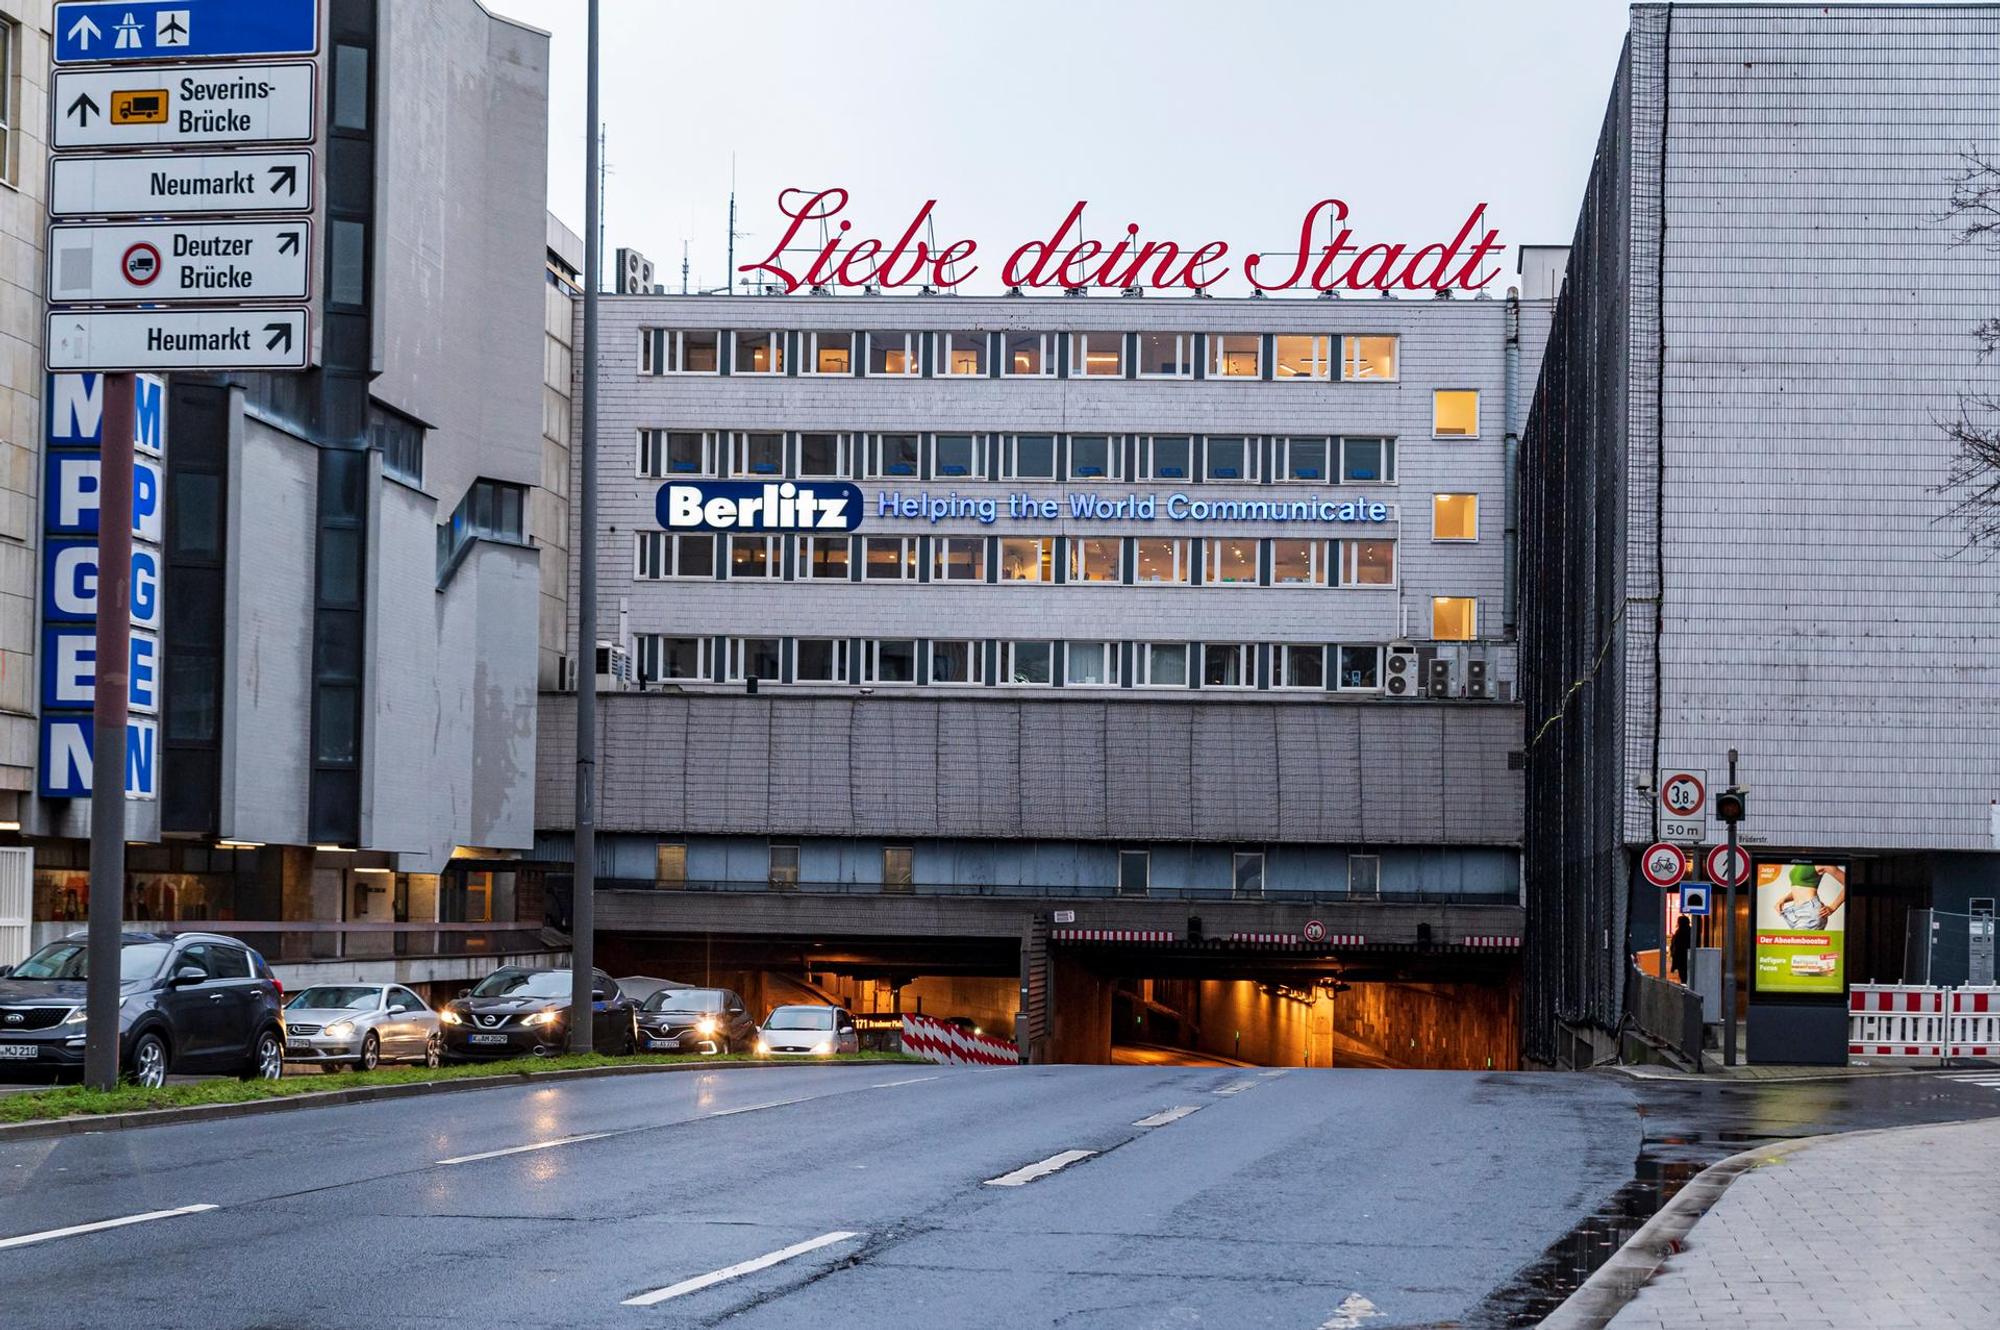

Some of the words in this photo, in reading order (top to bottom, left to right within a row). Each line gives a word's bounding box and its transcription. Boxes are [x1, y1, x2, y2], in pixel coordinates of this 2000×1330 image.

[180, 76, 276, 102] Severins-
[178, 109, 251, 133] Brücke
[150, 171, 255, 196] Neumarkt
[173, 234, 253, 257] Deutzer
[738, 188, 978, 294] Liebe
[1002, 201, 1230, 289] deine
[1244, 199, 1506, 291] Stadt
[181, 265, 252, 289] Brücke
[147, 327, 251, 352] Heumarkt
[669, 482, 849, 528] Berlitz
[879, 491, 997, 524] Helping
[1009, 493, 1058, 519] the
[1069, 493, 1155, 520] World
[1166, 493, 1387, 521] Communicate
[1667, 825, 1684, 835] 50
[1687, 827, 1698, 836] m
[1760, 936, 1773, 944] Der
[855, 1019, 868, 1029] 171
[19, 1047, 37, 1056] 210
